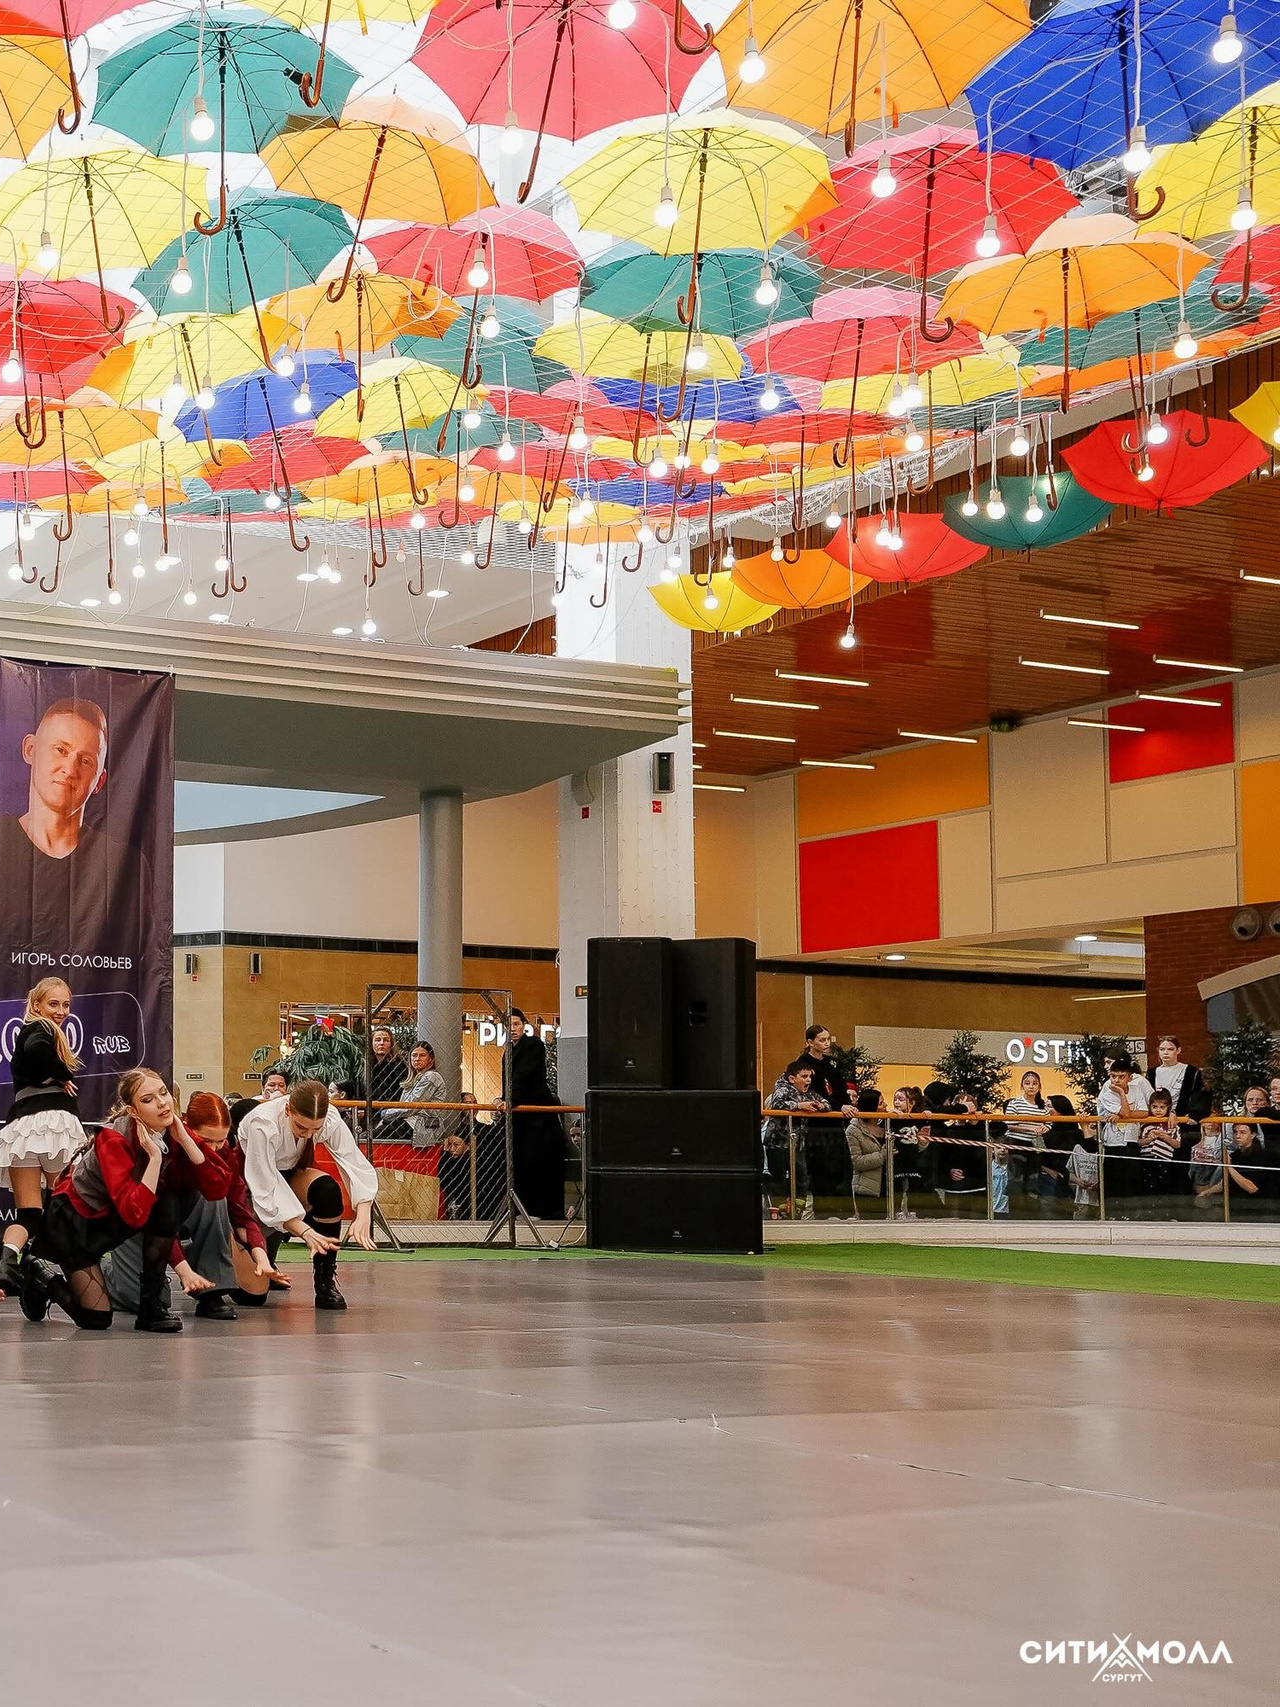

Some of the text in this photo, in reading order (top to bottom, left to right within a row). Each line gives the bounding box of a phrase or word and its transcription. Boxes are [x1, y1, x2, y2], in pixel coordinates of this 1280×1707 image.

[11, 951, 133, 970] ИГОРЬ СОЛОВЬЕВ
[92, 1035, 130, 1055] RUB
